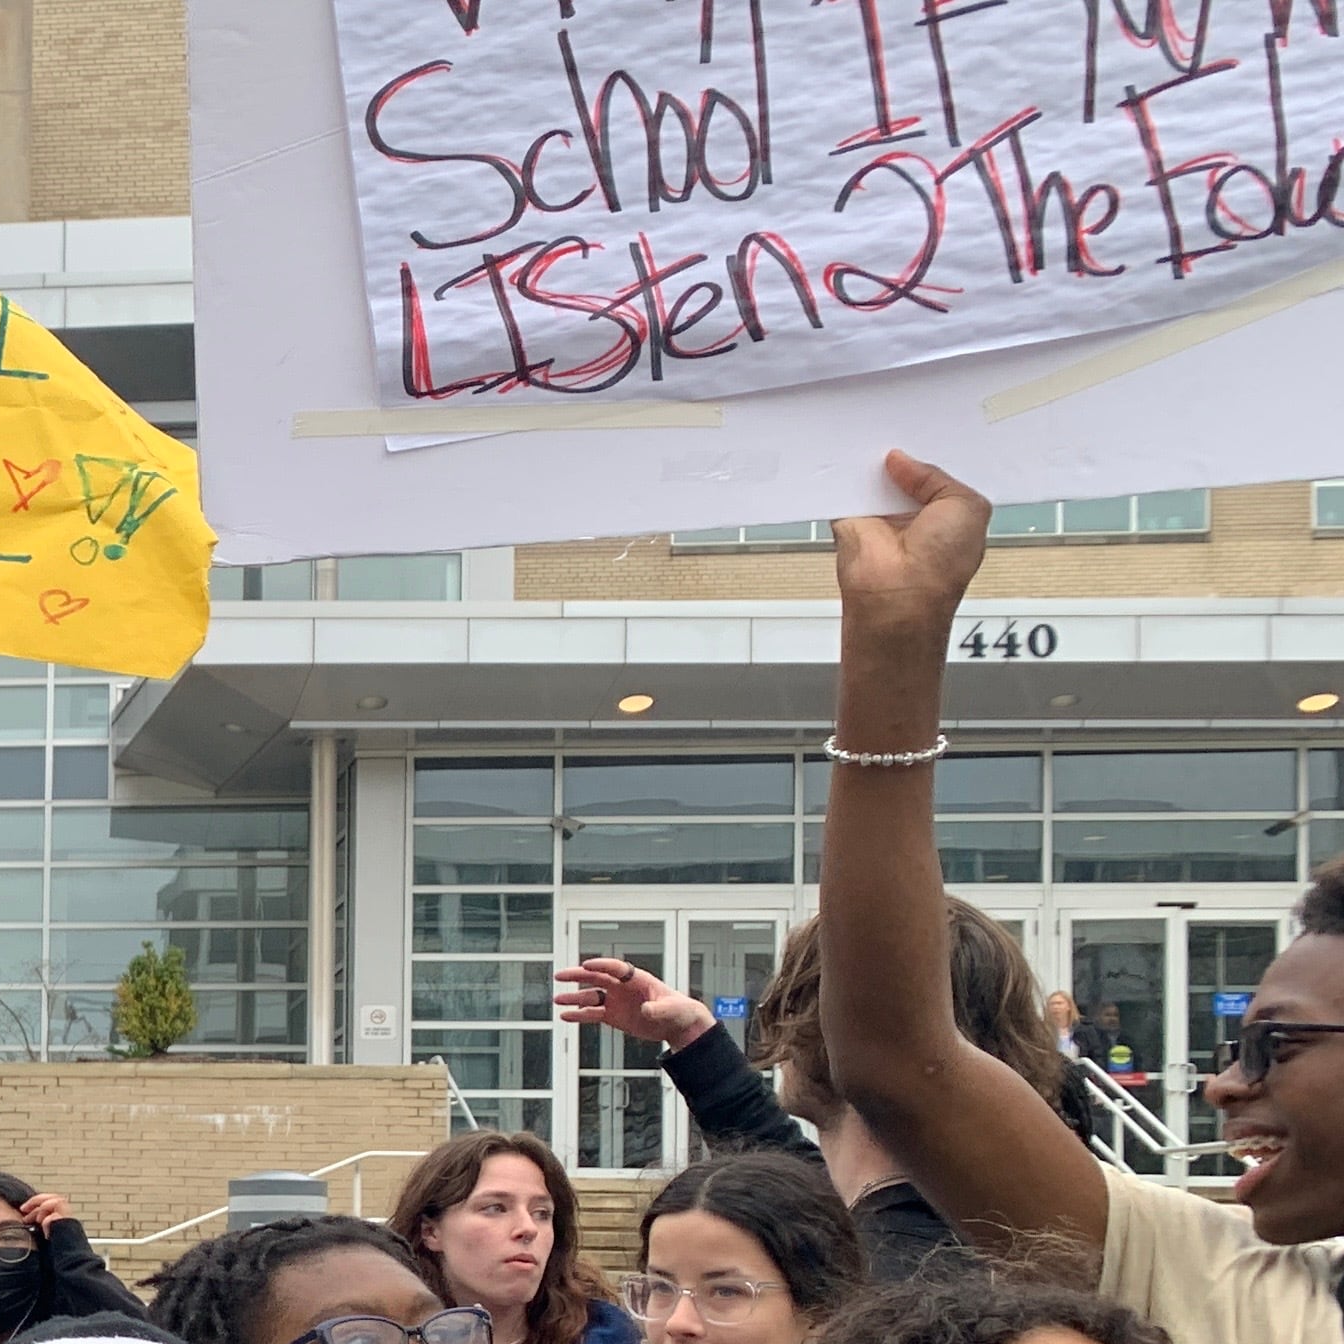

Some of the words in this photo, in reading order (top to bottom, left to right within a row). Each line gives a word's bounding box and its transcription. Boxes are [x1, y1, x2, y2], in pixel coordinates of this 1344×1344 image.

[823, 150, 964, 314] 2
[936, 105, 1127, 284] The
[959, 620, 1058, 658] 440
